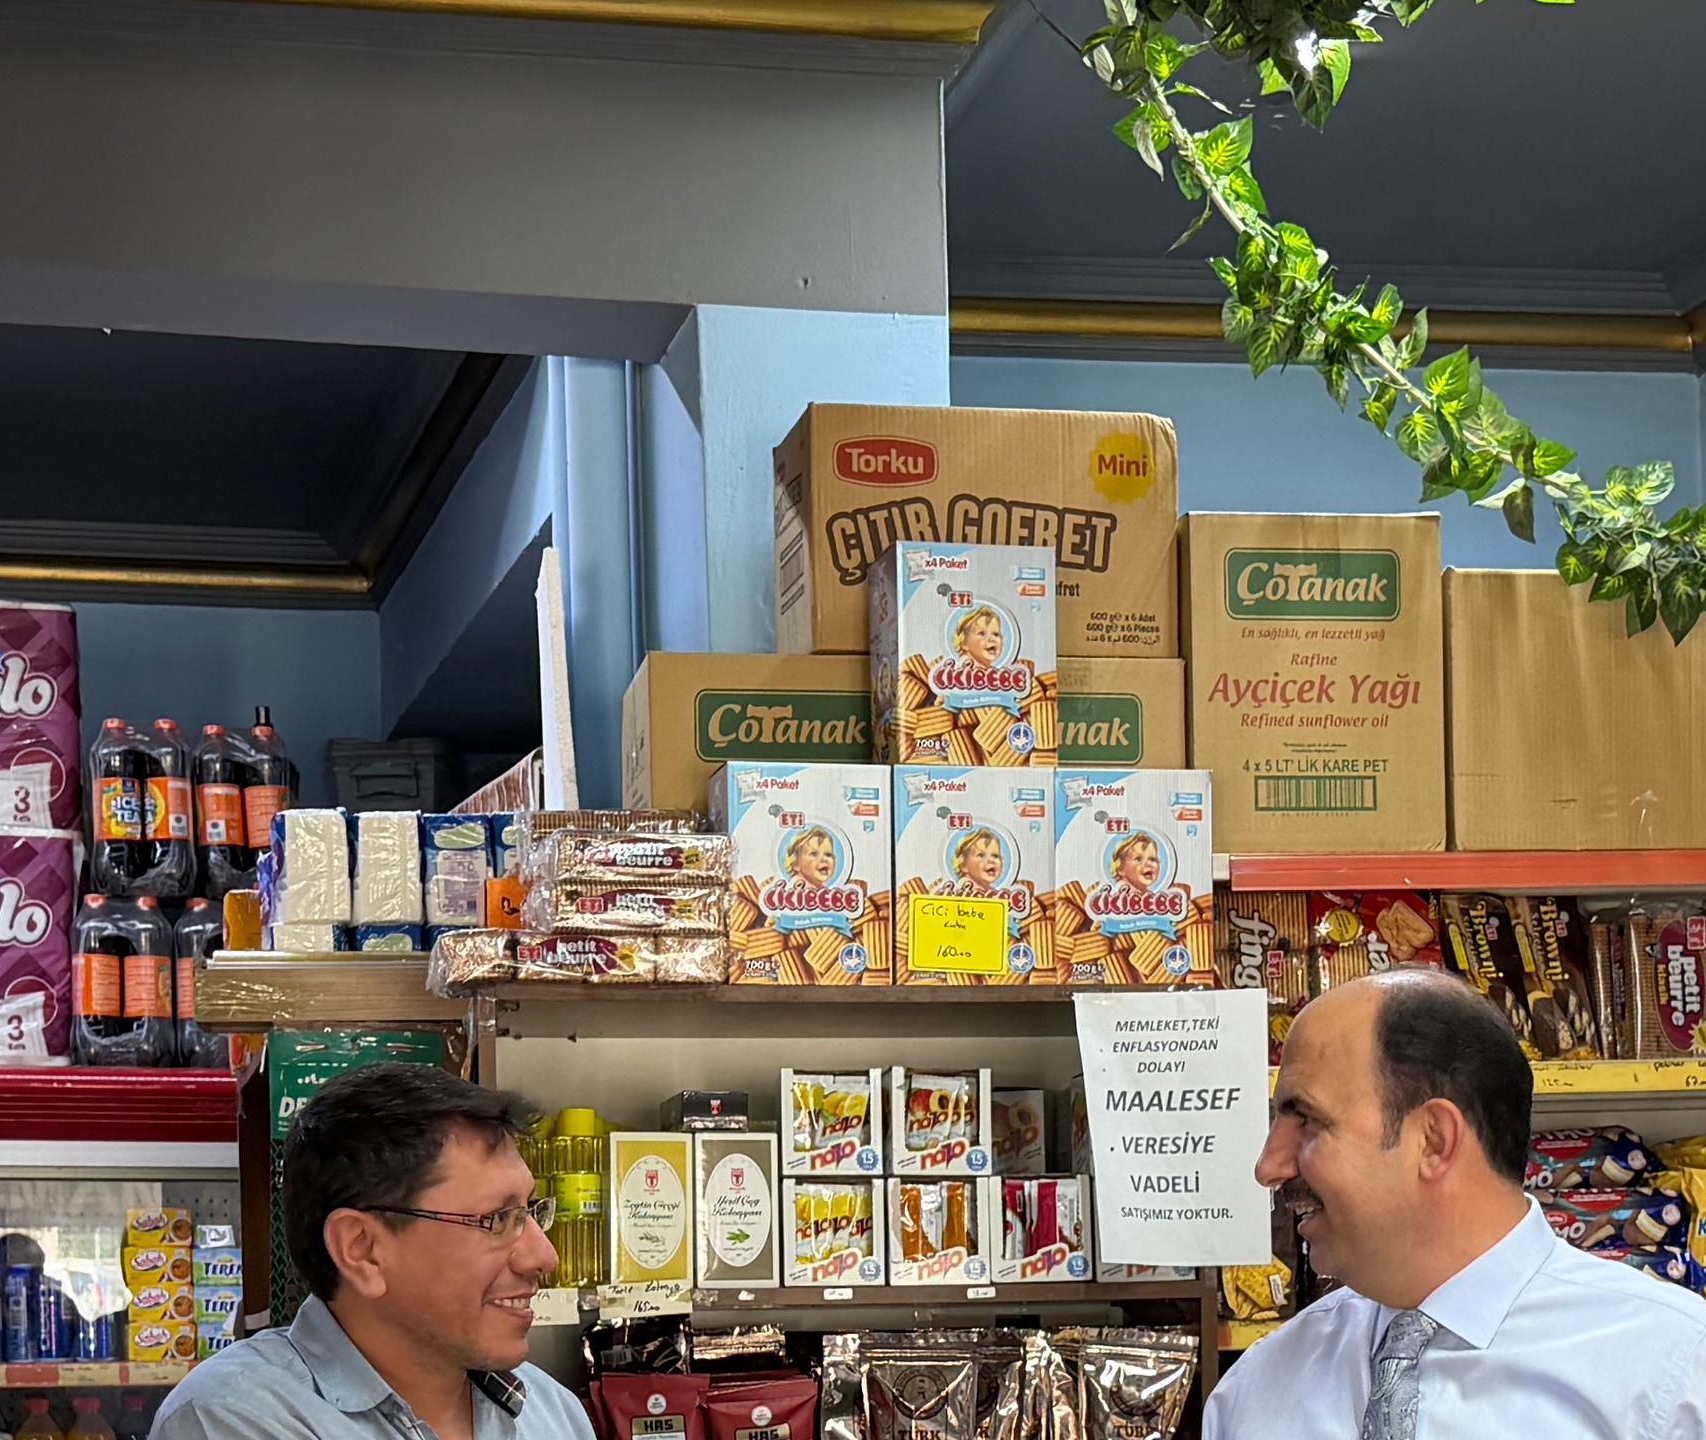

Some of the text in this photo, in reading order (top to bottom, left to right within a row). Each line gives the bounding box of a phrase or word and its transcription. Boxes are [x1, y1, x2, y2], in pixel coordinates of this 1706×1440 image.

[847, 446, 924, 475] Torku
[1097, 454, 1148, 478] Mini
[942, 557, 967, 570] Paket
[1241, 628, 1257, 640] En
[1305, 629, 1319, 640] en
[1322, 626, 1360, 640] lezzetli
[1363, 628, 1386, 642] yağ
[1290, 653, 1337, 666] Rafine
[1210, 672, 1420, 710] Ayçiçek Yağı
[1241, 713, 1388, 729] Refined sunflower oil
[1243, 759, 1250, 771] 4
[1253, 762, 1260, 771] x
[1264, 759, 1271, 771] 5
[1297, 756, 1320, 771] LİK
[1324, 759, 1356, 771] KARE
[1360, 759, 1388, 771] PET
[1113, 1040, 1218, 1053] ENFLASYONDAN
[1137, 1061, 1185, 1073] DOLAYI
[1105, 1088, 1240, 1111] MAALESEF
[1122, 1132, 1215, 1154] VERESİYE
[1130, 1171, 1200, 1193] VADELİ
[1121, 1207, 1233, 1221] SATIŞIMIZ YOKTUR.
[644, 1419, 673, 1432] HAS
